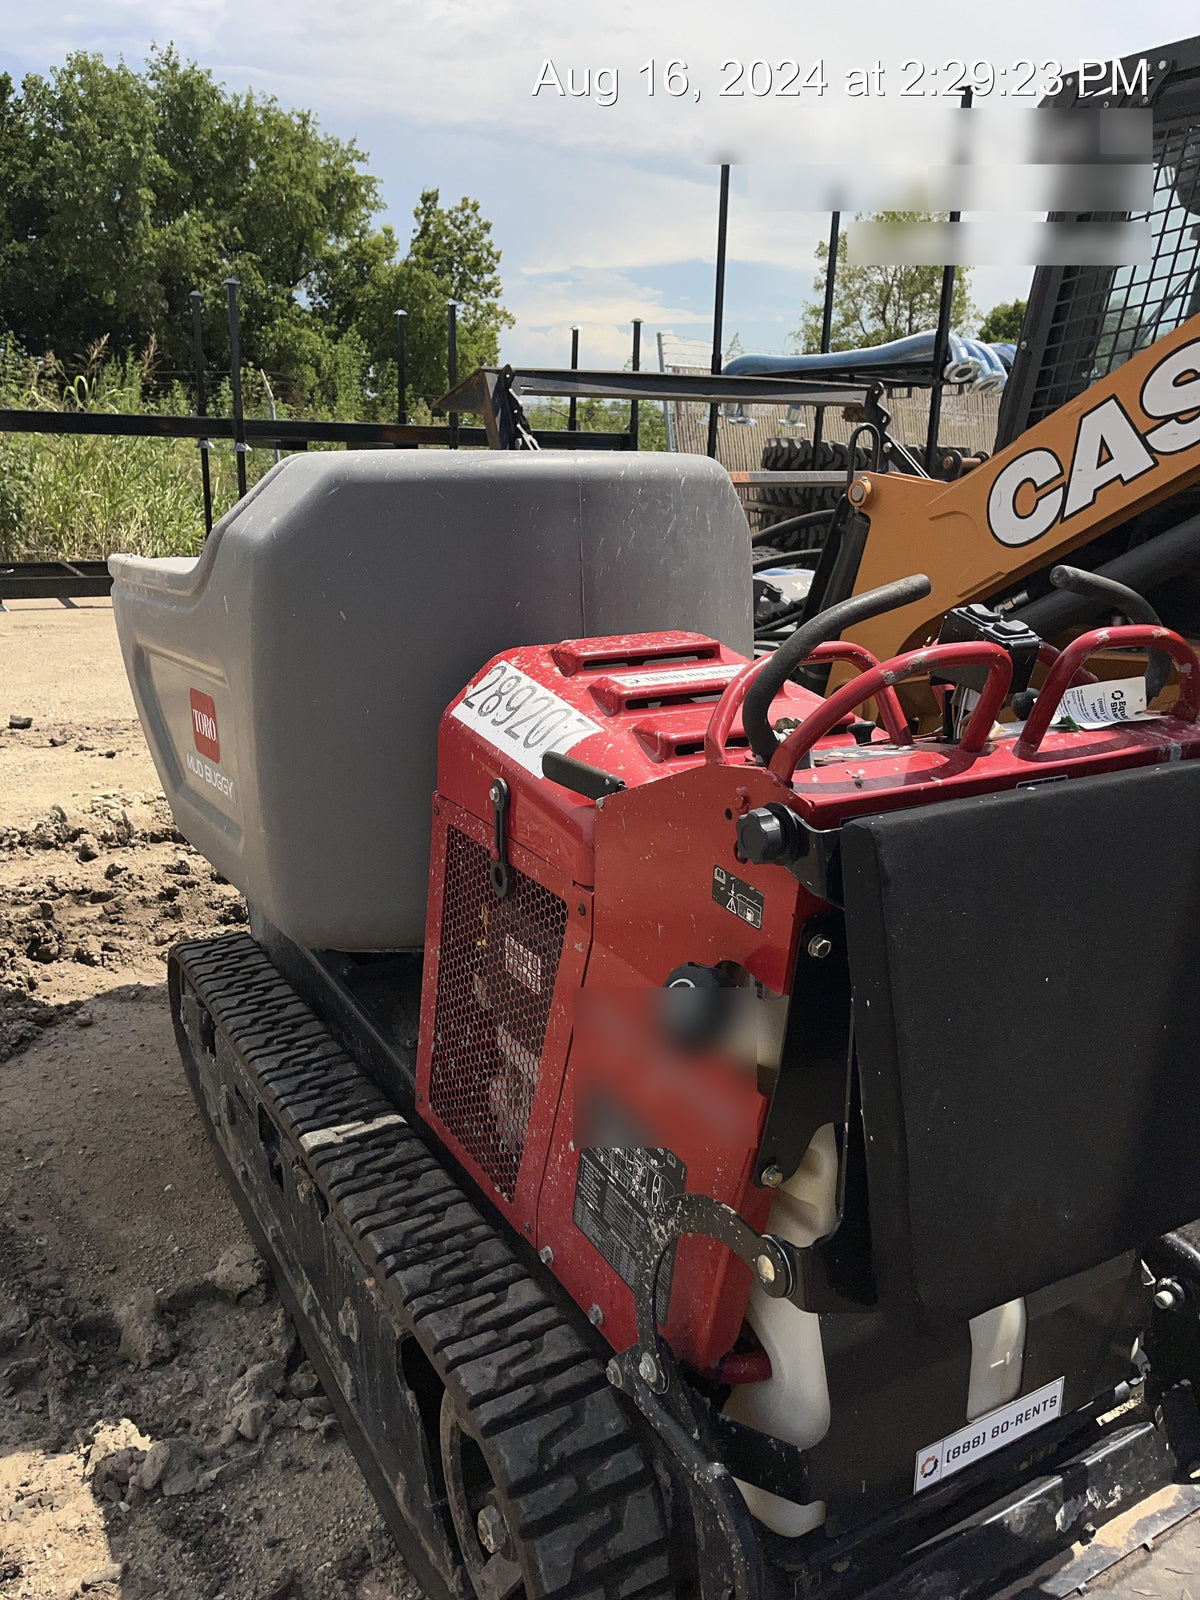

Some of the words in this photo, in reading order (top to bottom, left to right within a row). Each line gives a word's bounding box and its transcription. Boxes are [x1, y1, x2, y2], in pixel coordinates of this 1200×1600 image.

[192, 708, 216, 742] TORO
[461, 664, 595, 758] 289207
[186, 753, 204, 779] MUD
[204, 764, 234, 800] BUGGY
[991, 1395, 1058, 1439] 80-RENTS
